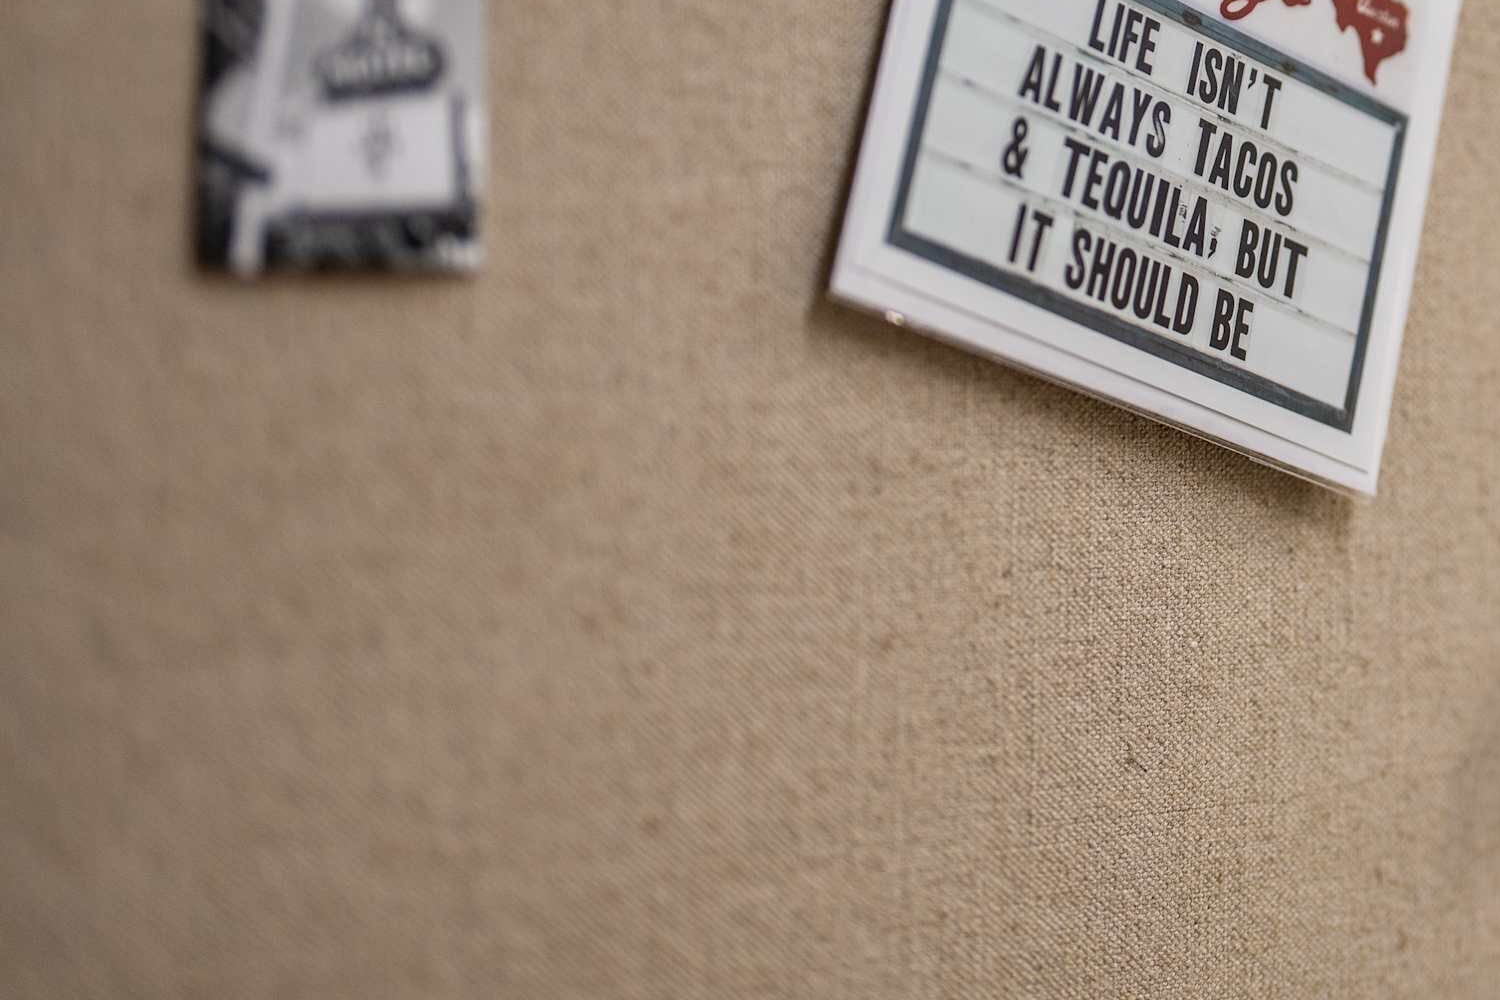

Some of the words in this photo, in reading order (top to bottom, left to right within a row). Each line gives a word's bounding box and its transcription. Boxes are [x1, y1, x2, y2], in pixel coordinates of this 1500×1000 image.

[1018, 45, 1171, 158] ALWAYS
[1193, 118, 1298, 217] TACOS
[1186, 41, 1282, 130] ISN'T
[1003, 117, 1030, 179] &
[1235, 218, 1308, 299] BUT
[1008, 203, 1054, 273] IT
[1064, 228, 1200, 336] SHOULD
[1209, 288, 1255, 362] BE
